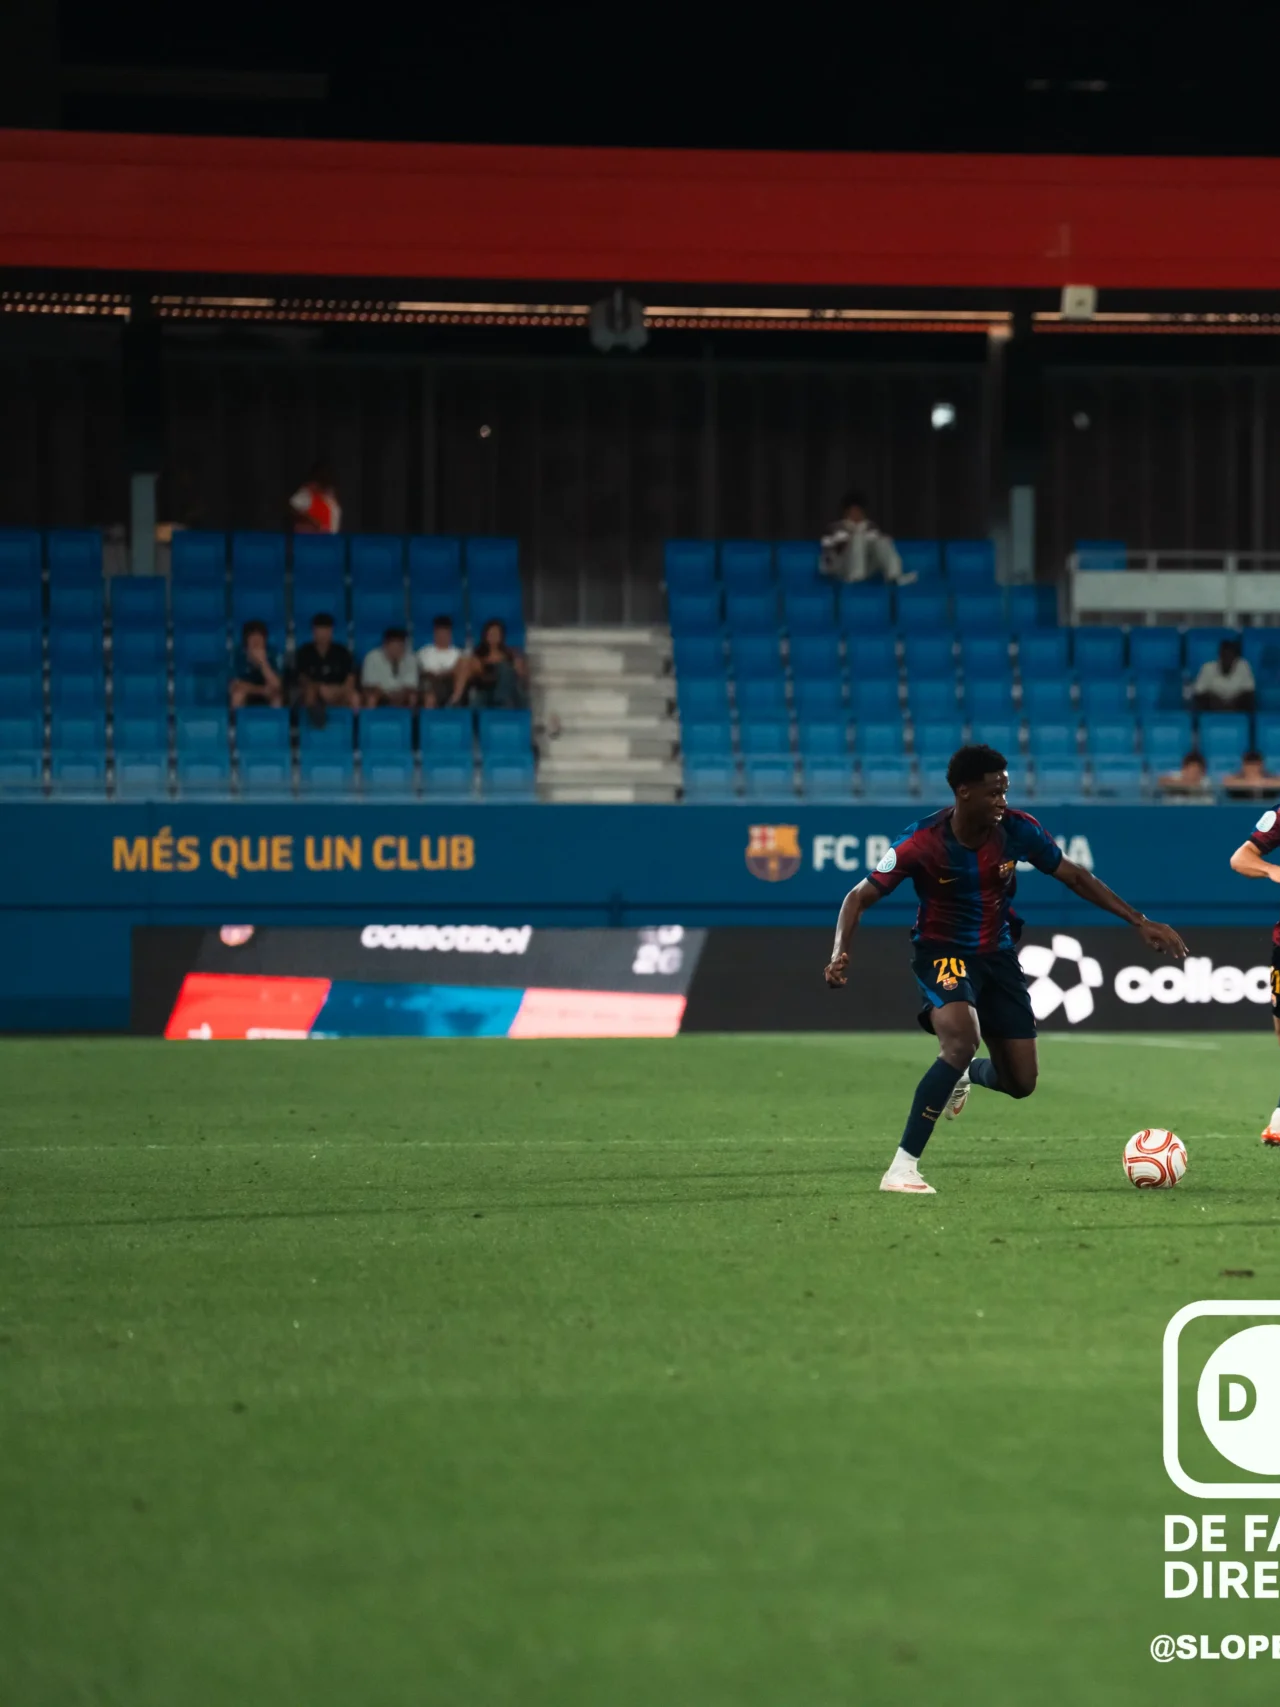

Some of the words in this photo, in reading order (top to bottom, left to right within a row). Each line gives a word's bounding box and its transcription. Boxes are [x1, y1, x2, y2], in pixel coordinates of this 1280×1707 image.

[112, 826, 200, 871] MÉS
[211, 836, 293, 878] QUE
[305, 836, 361, 870] UN
[372, 836, 475, 870] CLUB
[812, 835, 859, 871] FC
[933, 957, 967, 985] 20
